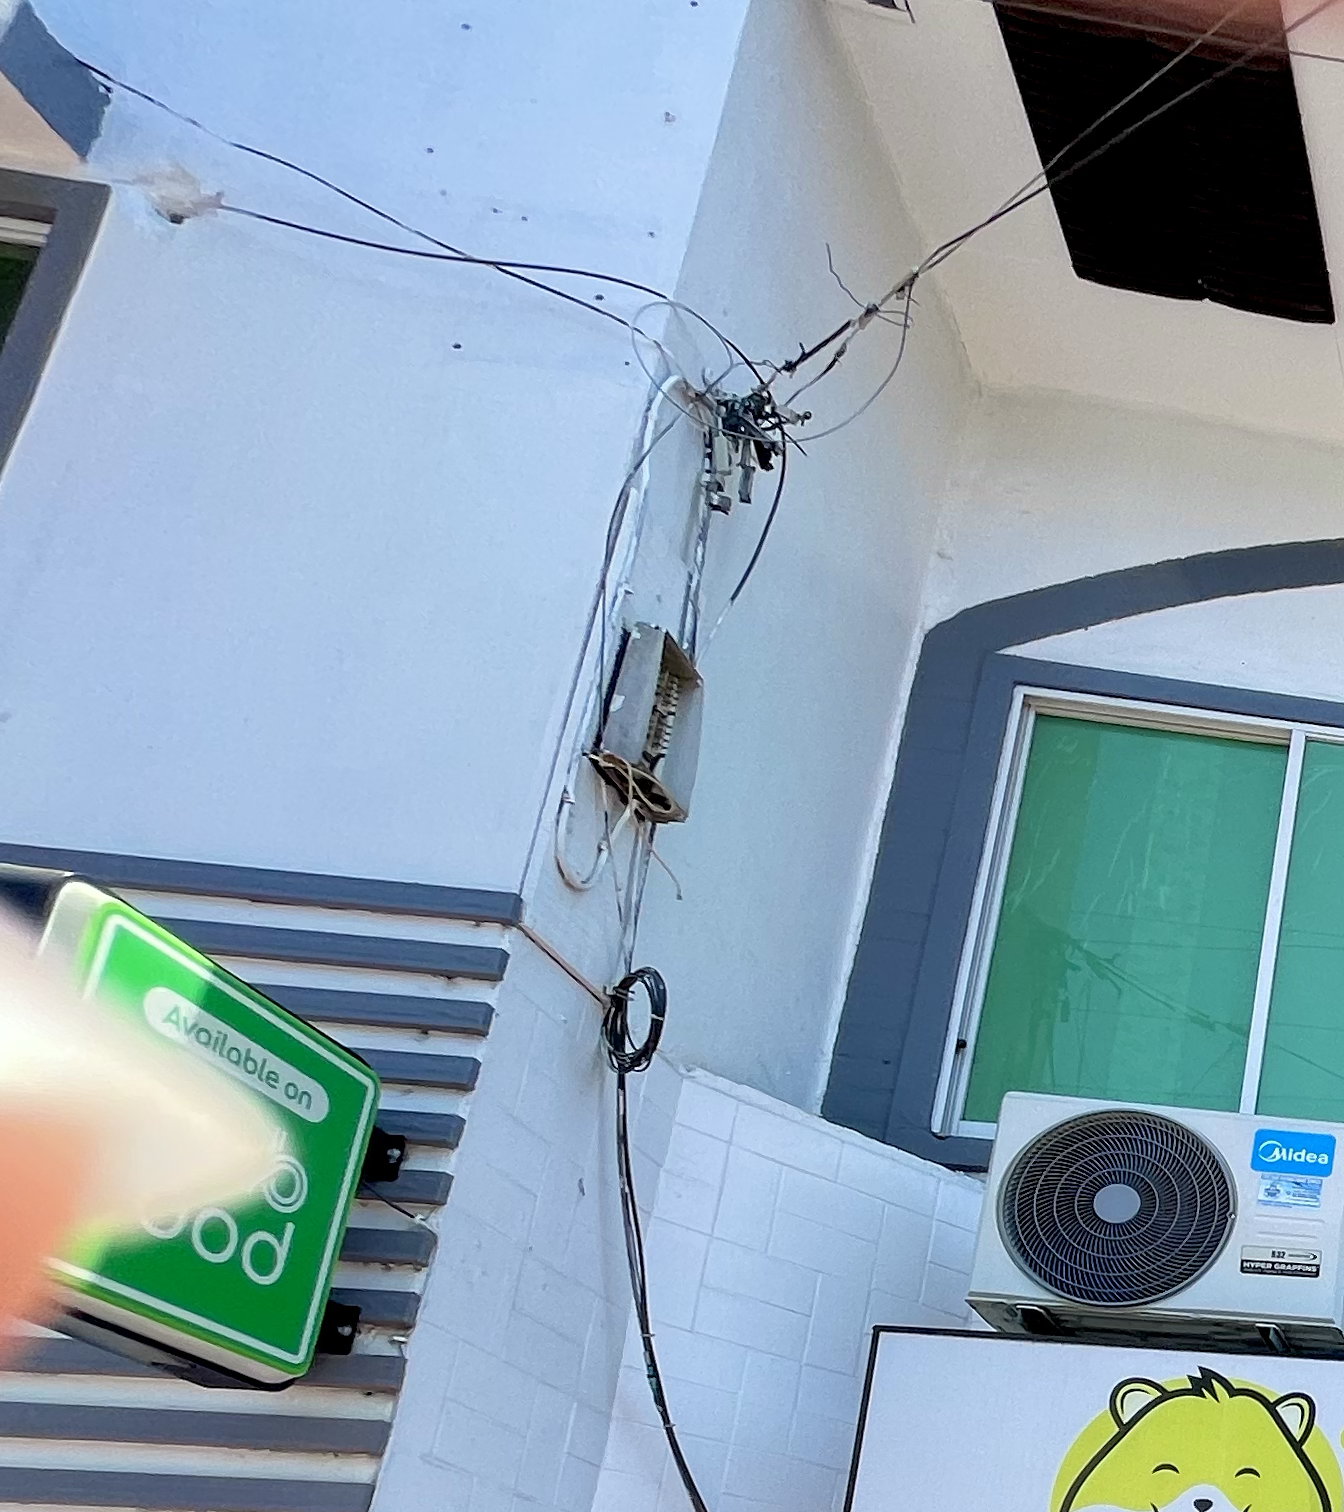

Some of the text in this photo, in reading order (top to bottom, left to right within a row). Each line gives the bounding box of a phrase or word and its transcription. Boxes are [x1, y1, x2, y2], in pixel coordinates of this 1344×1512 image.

[162, 1005, 313, 1110] Available on
[1257, 1140, 1330, 1166] Midea
